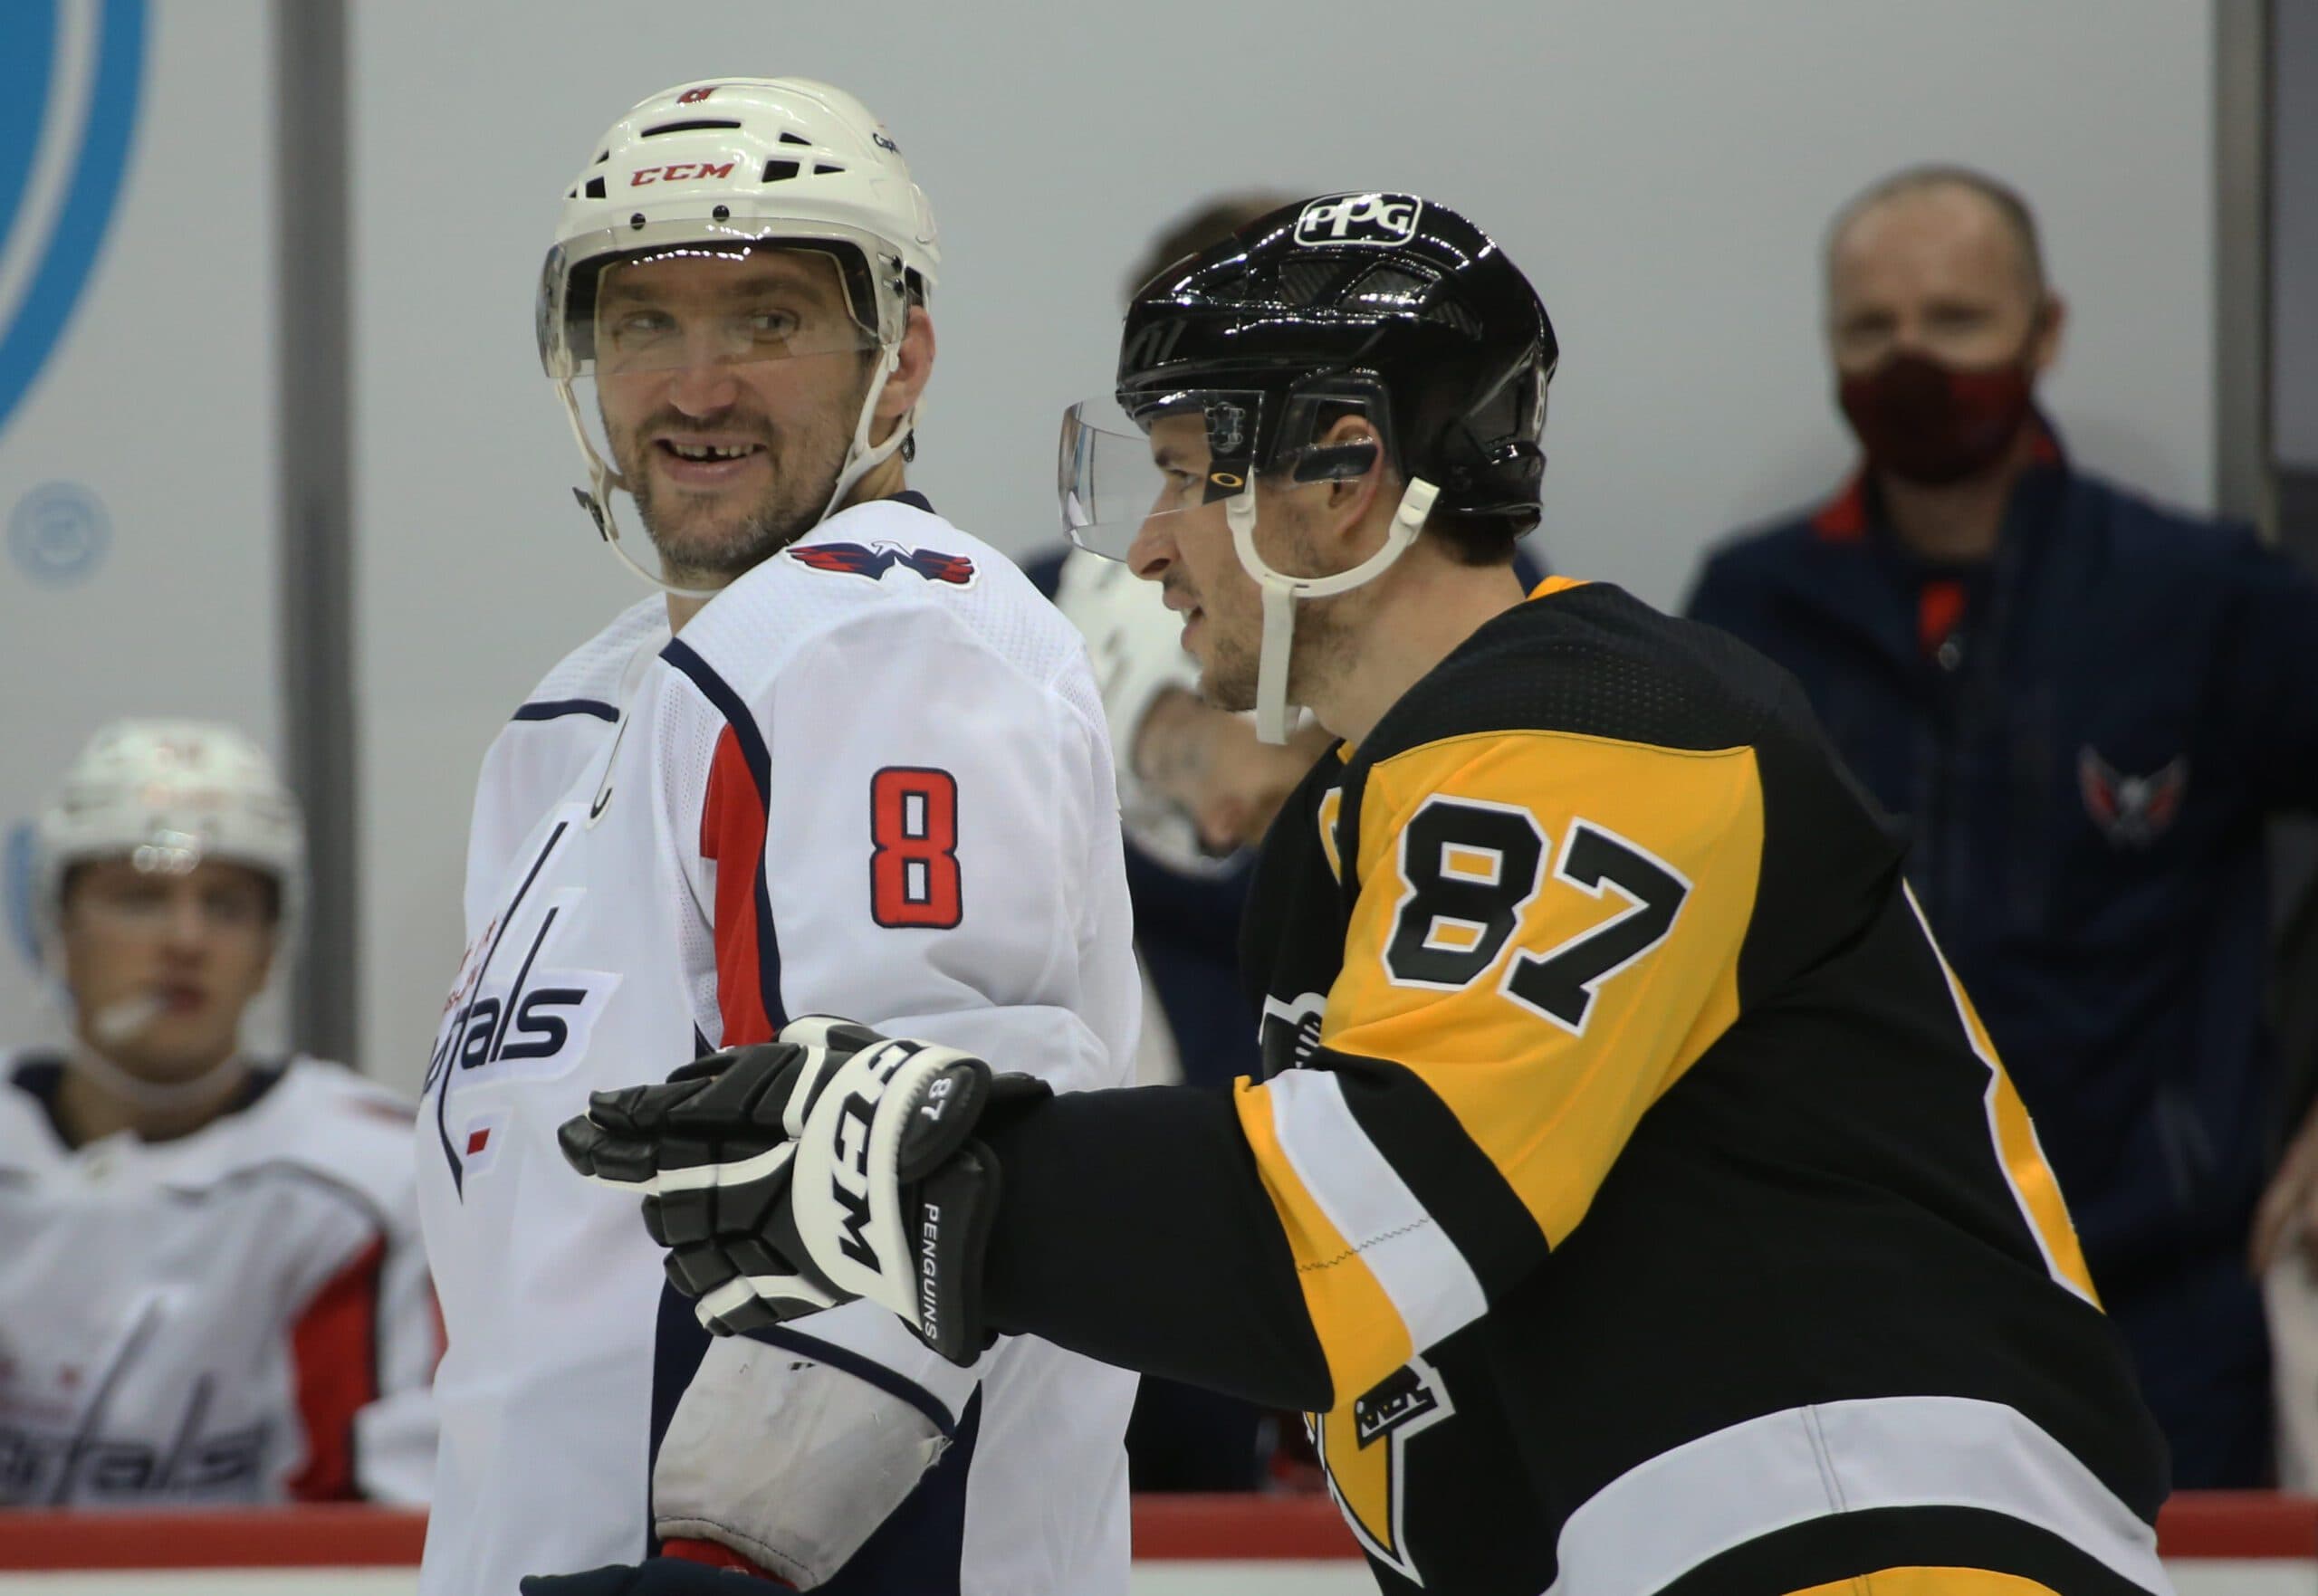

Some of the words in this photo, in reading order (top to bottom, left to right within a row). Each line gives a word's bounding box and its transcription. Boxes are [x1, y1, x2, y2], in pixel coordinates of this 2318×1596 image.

[630, 163, 734, 187] CCM
[1304, 194, 1413, 236] PPG
[870, 766, 963, 930] 8
[1382, 793, 1694, 1037] 87
[921, 1077, 953, 1121] 87
[921, 1202, 940, 1341] PENGUINS
